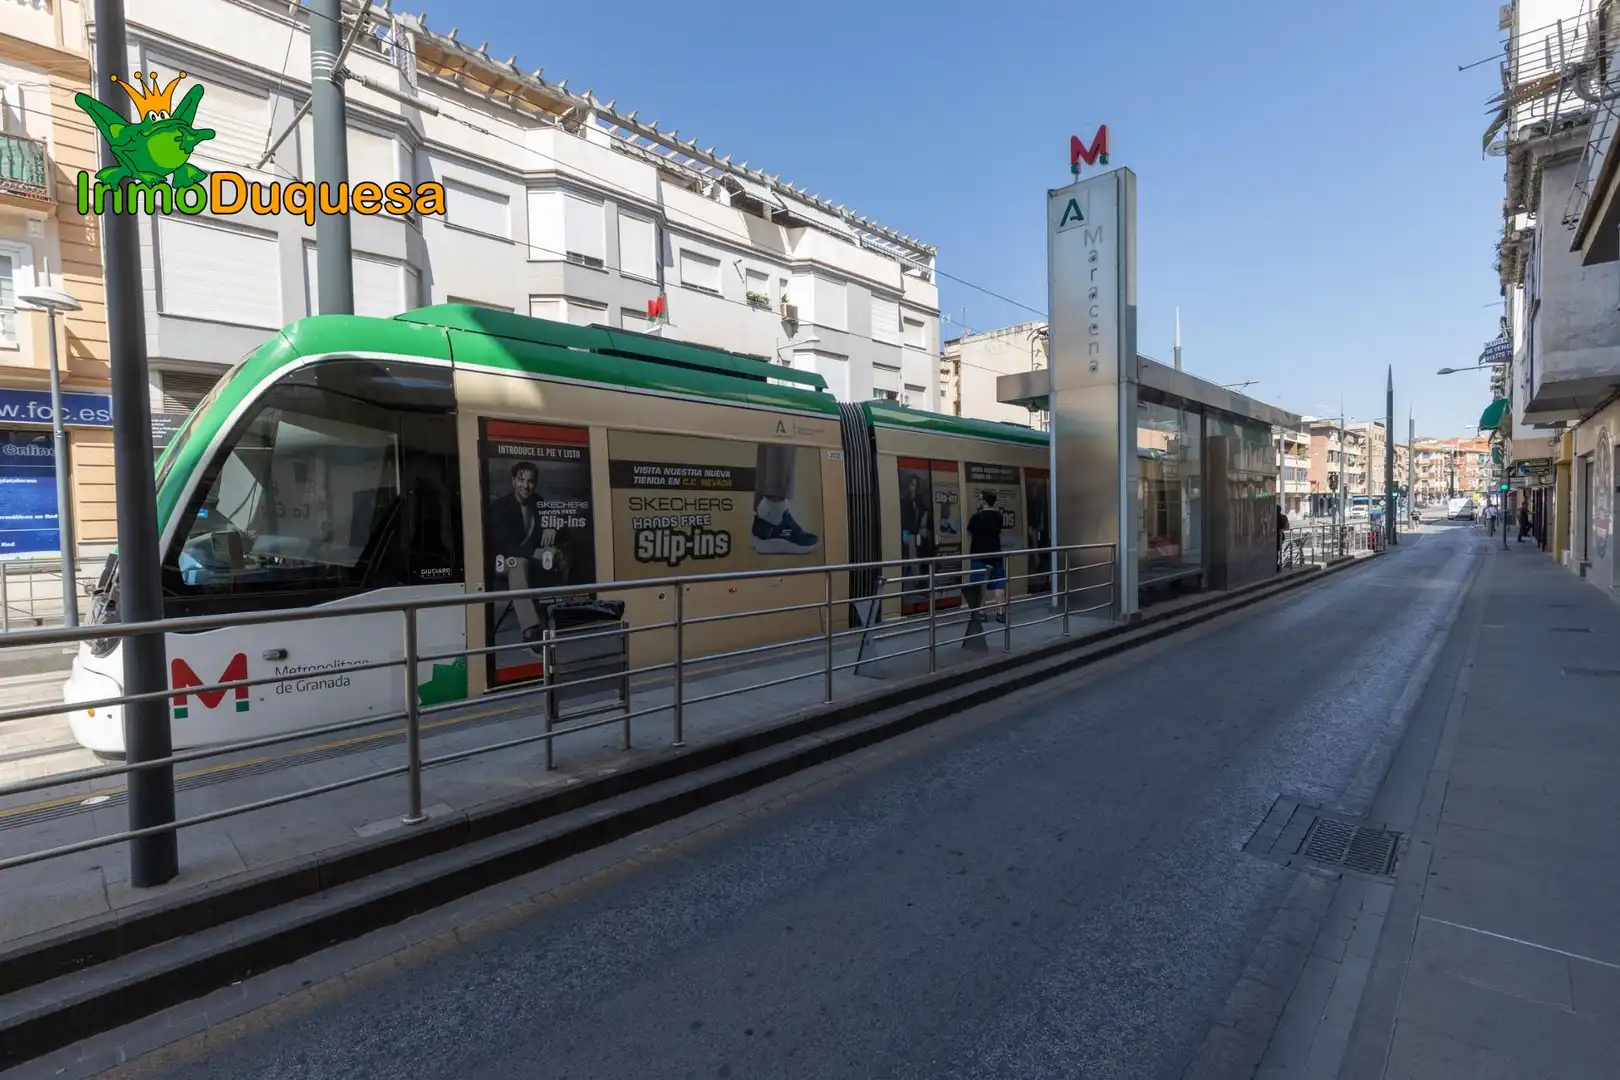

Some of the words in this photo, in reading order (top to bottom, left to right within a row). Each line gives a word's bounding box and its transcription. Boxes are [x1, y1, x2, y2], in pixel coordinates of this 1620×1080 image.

[1083, 225, 1103, 373] Maracena
[498, 445, 536, 457] INTRODUCE
[537, 448, 545, 457] EL
[546, 448, 557, 457] PIE
[558, 449, 562, 458] Y
[563, 450, 580, 459] LISTO
[633, 466, 662, 475] VISITA
[663, 467, 703, 477] NUESTRA
[704, 469, 731, 478] NUEVA
[633, 476, 666, 485] TIENDA
[667, 477, 681, 486] EN
[536, 501, 588, 509] SKECHERS
[628, 496, 734, 511] SKECHERS
[540, 515, 586, 530] Slip-ins
[681, 515, 711, 526] FREE
[637, 529, 731, 564] Slip-ins
[275, 681, 292, 695] de
[296, 675, 351, 692] Granada
